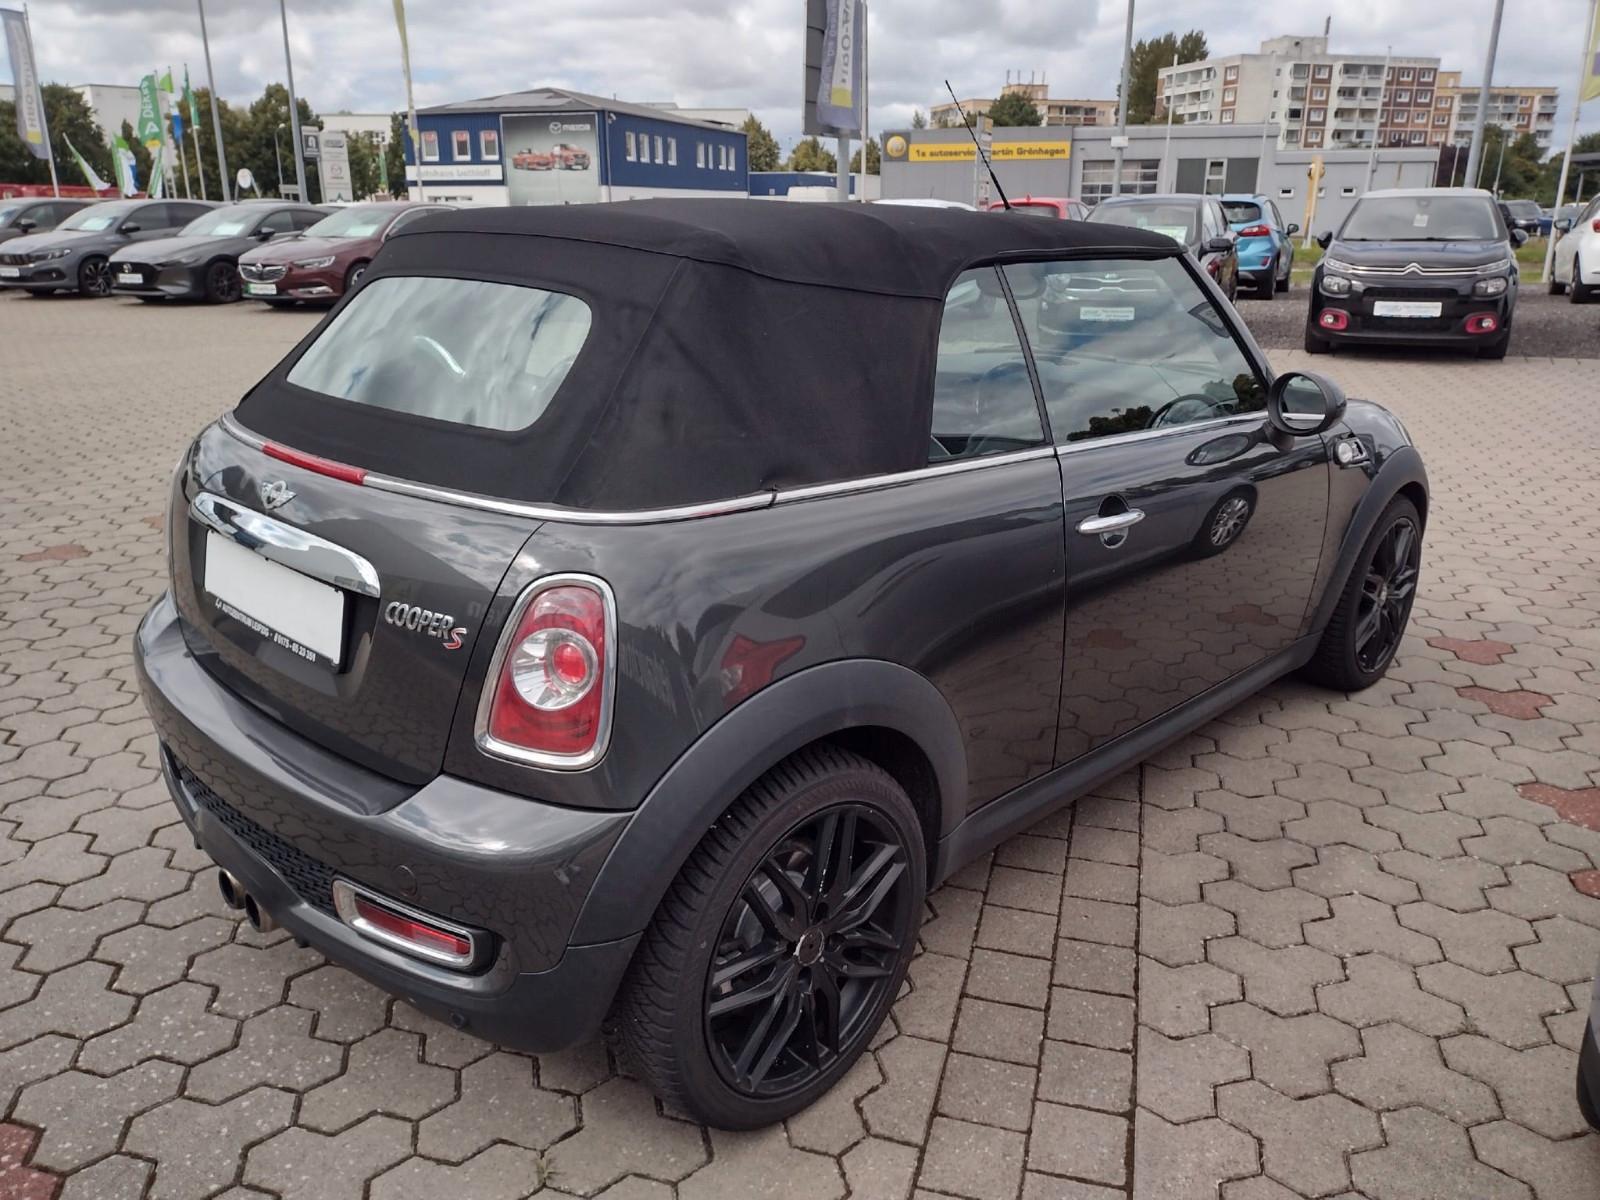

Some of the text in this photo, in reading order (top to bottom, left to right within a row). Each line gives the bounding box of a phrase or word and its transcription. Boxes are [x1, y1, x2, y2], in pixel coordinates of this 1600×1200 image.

[929, 149, 977, 157] autoservic
[991, 147, 1013, 156] artin
[385, 601, 467, 650] COOPER S
